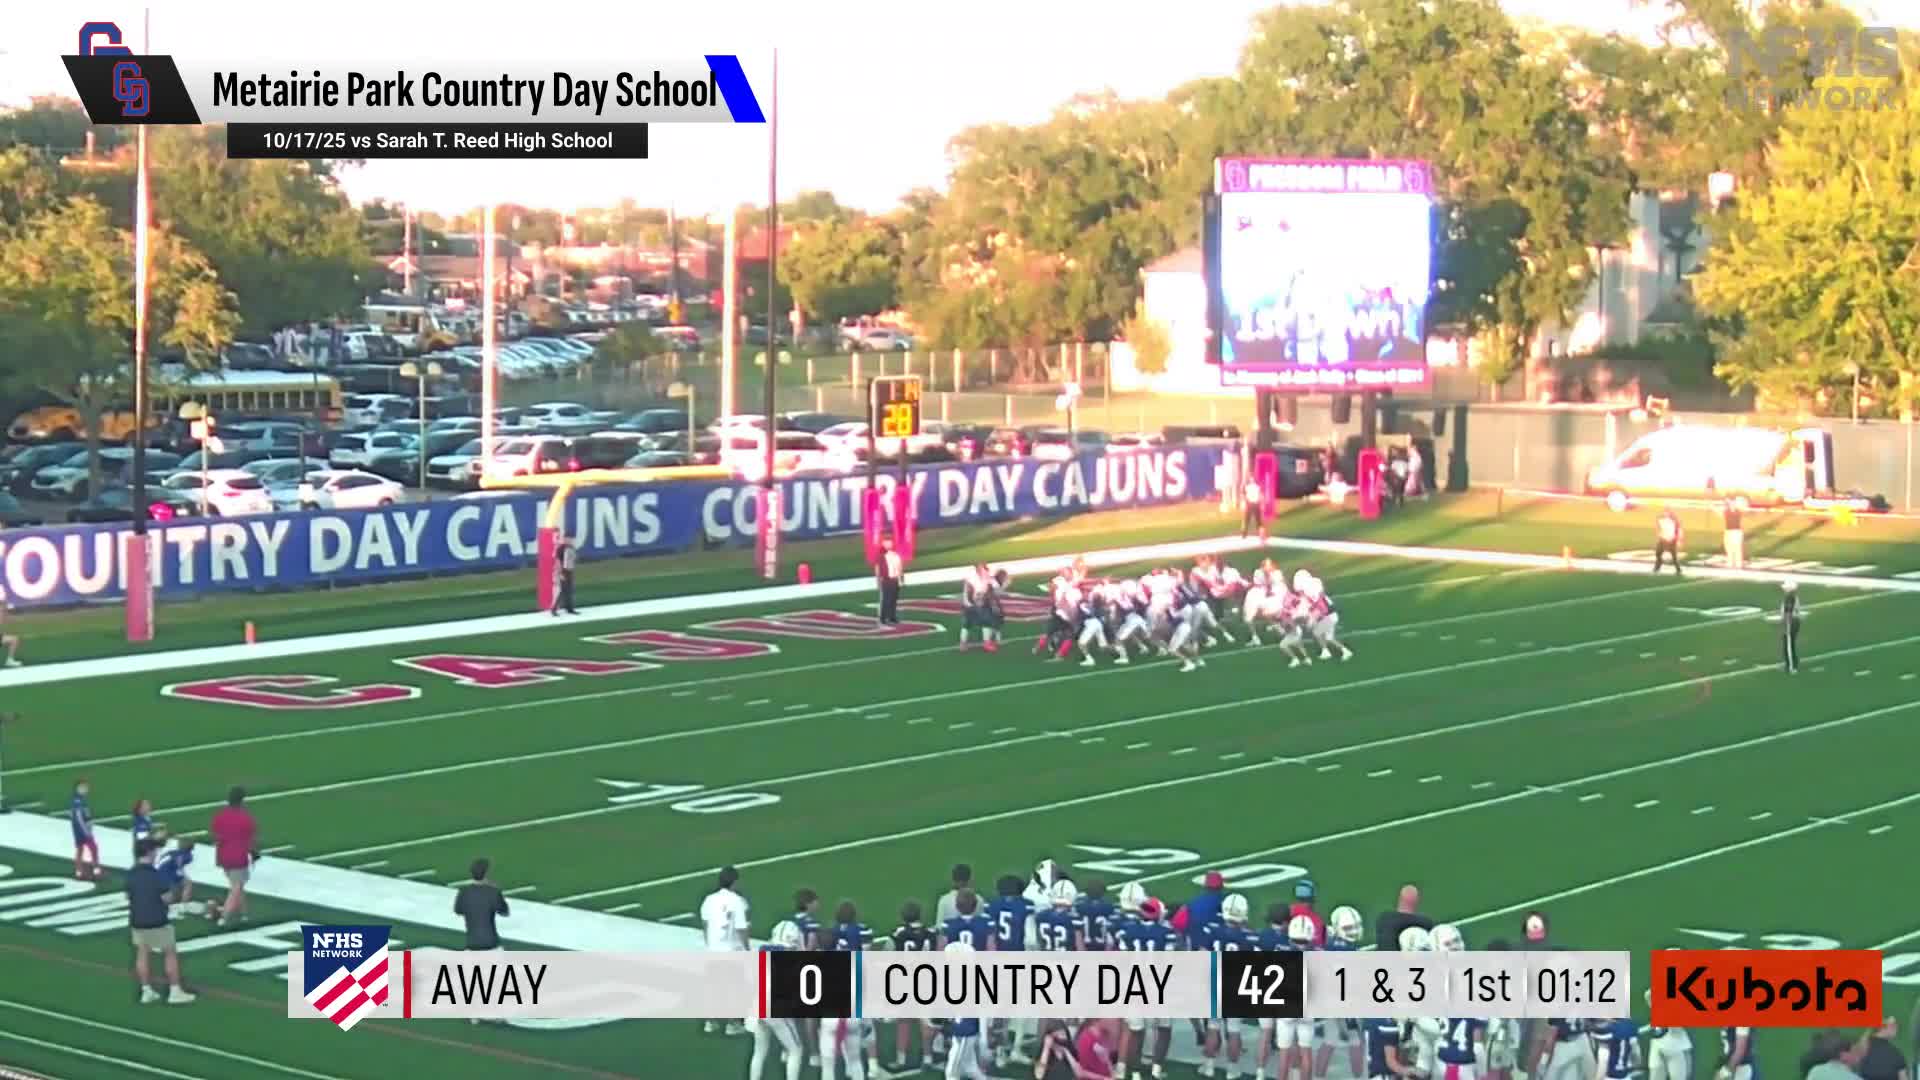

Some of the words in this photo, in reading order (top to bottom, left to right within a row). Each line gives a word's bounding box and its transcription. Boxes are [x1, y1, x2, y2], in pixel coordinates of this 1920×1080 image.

[702, 470, 929, 538] COUNTRY
[939, 465, 1024, 518] DAY
[1034, 451, 1189, 509] CAJUNS
[0, 529, 296, 599] OUNTRY
[309, 510, 430, 573] DAY
[446, 494, 662, 560] CAJUNS
